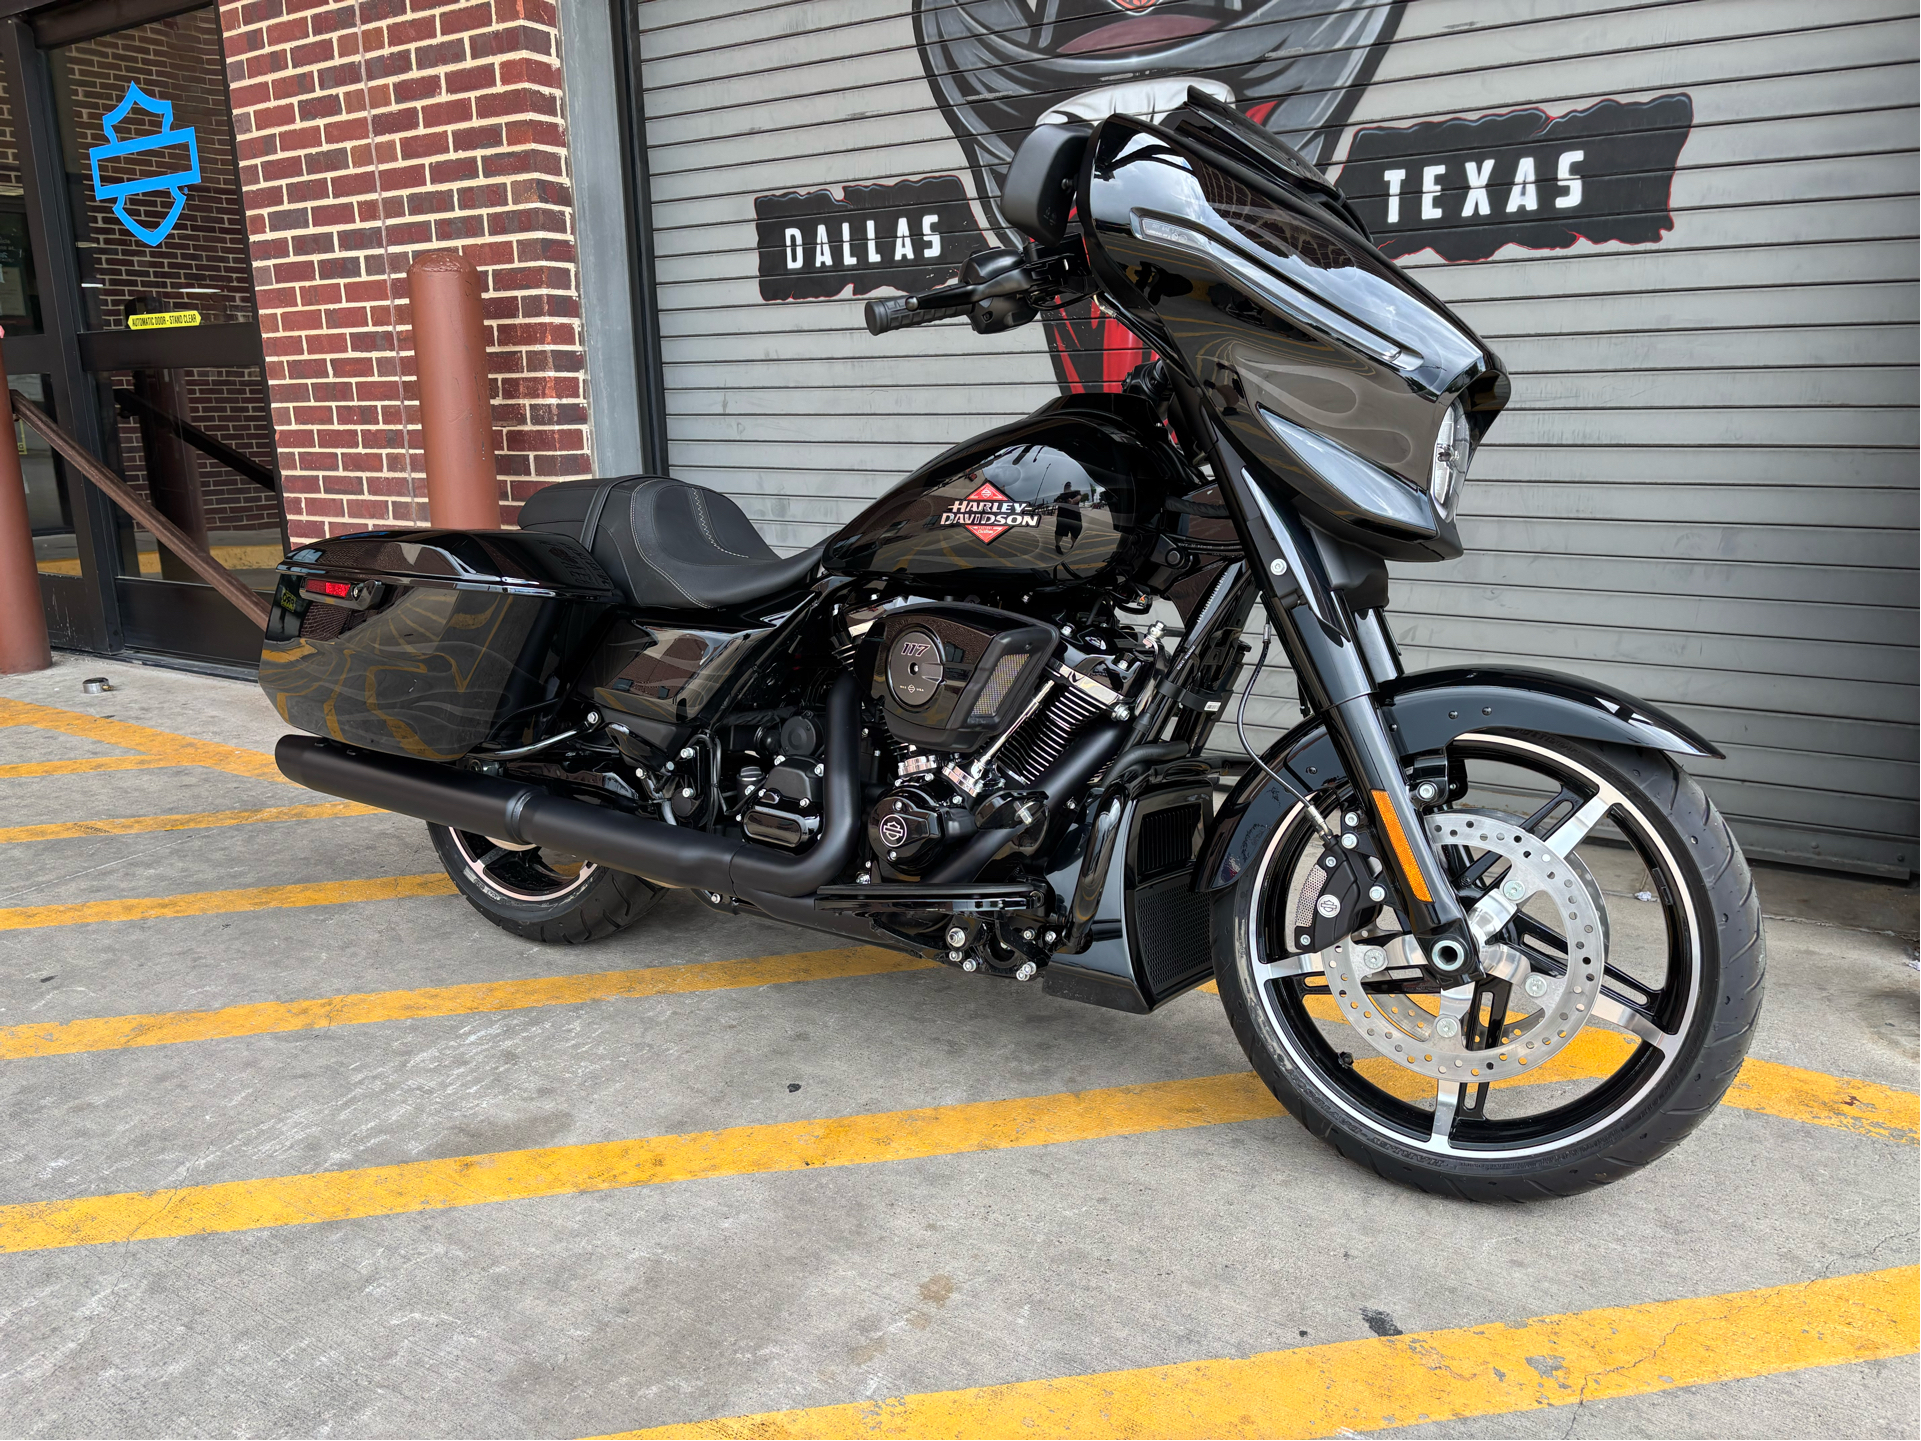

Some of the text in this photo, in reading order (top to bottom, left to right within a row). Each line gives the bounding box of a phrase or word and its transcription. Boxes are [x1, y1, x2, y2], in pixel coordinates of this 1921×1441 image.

[1384, 150, 1584, 223] TEXAS
[785, 215, 941, 269] DALLAS
[132, 317, 154, 327] AUTOMATIC
[155, 316, 166, 326] DOOR
[169, 315, 183, 325] STAND
[183, 314, 197, 324] CLEAR
[940, 513, 1038, 526] DAVIDSON
[901, 642, 931, 657] 117
